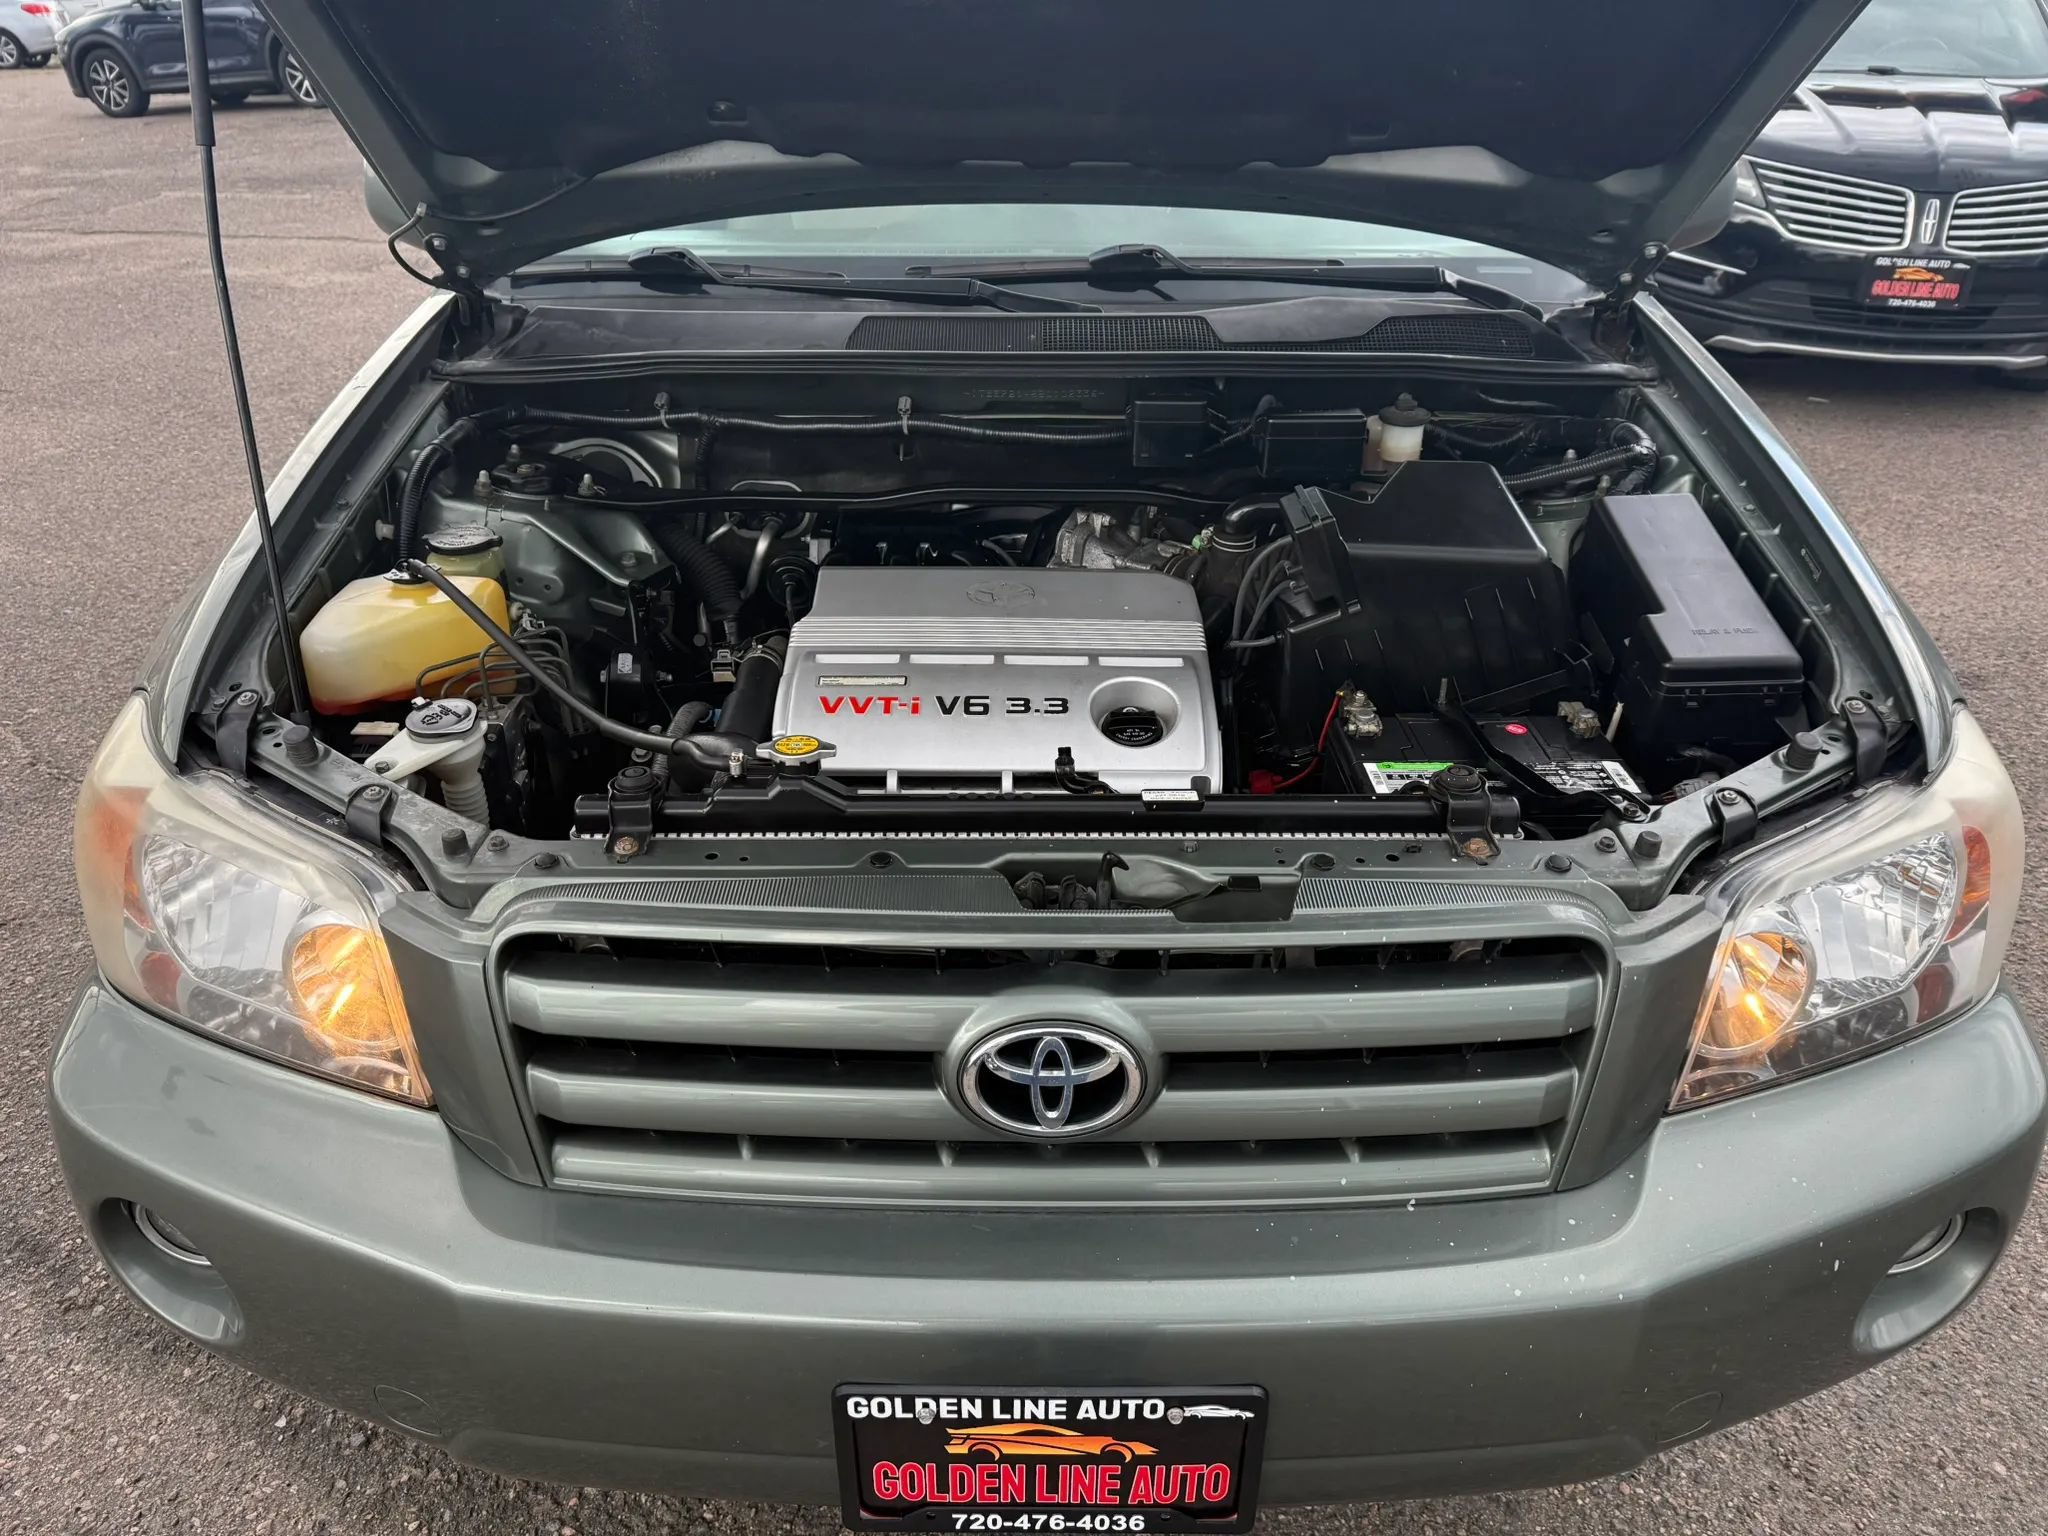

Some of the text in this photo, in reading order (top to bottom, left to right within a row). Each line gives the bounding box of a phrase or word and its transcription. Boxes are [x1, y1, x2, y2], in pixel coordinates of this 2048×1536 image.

[1909, 258, 1928, 267] LINE
[1928, 259, 1951, 269] AUTO
[1872, 280, 1960, 300] GOLDEN LINE AUTO
[817, 695, 1069, 716] VVT-i V6 3.3
[846, 1397, 1165, 1420] GOLDEN LINE AUTO
[872, 1460, 1231, 1504] GOLDEN LINE AUTO
[951, 1513, 1145, 1532] 720-476-4036
